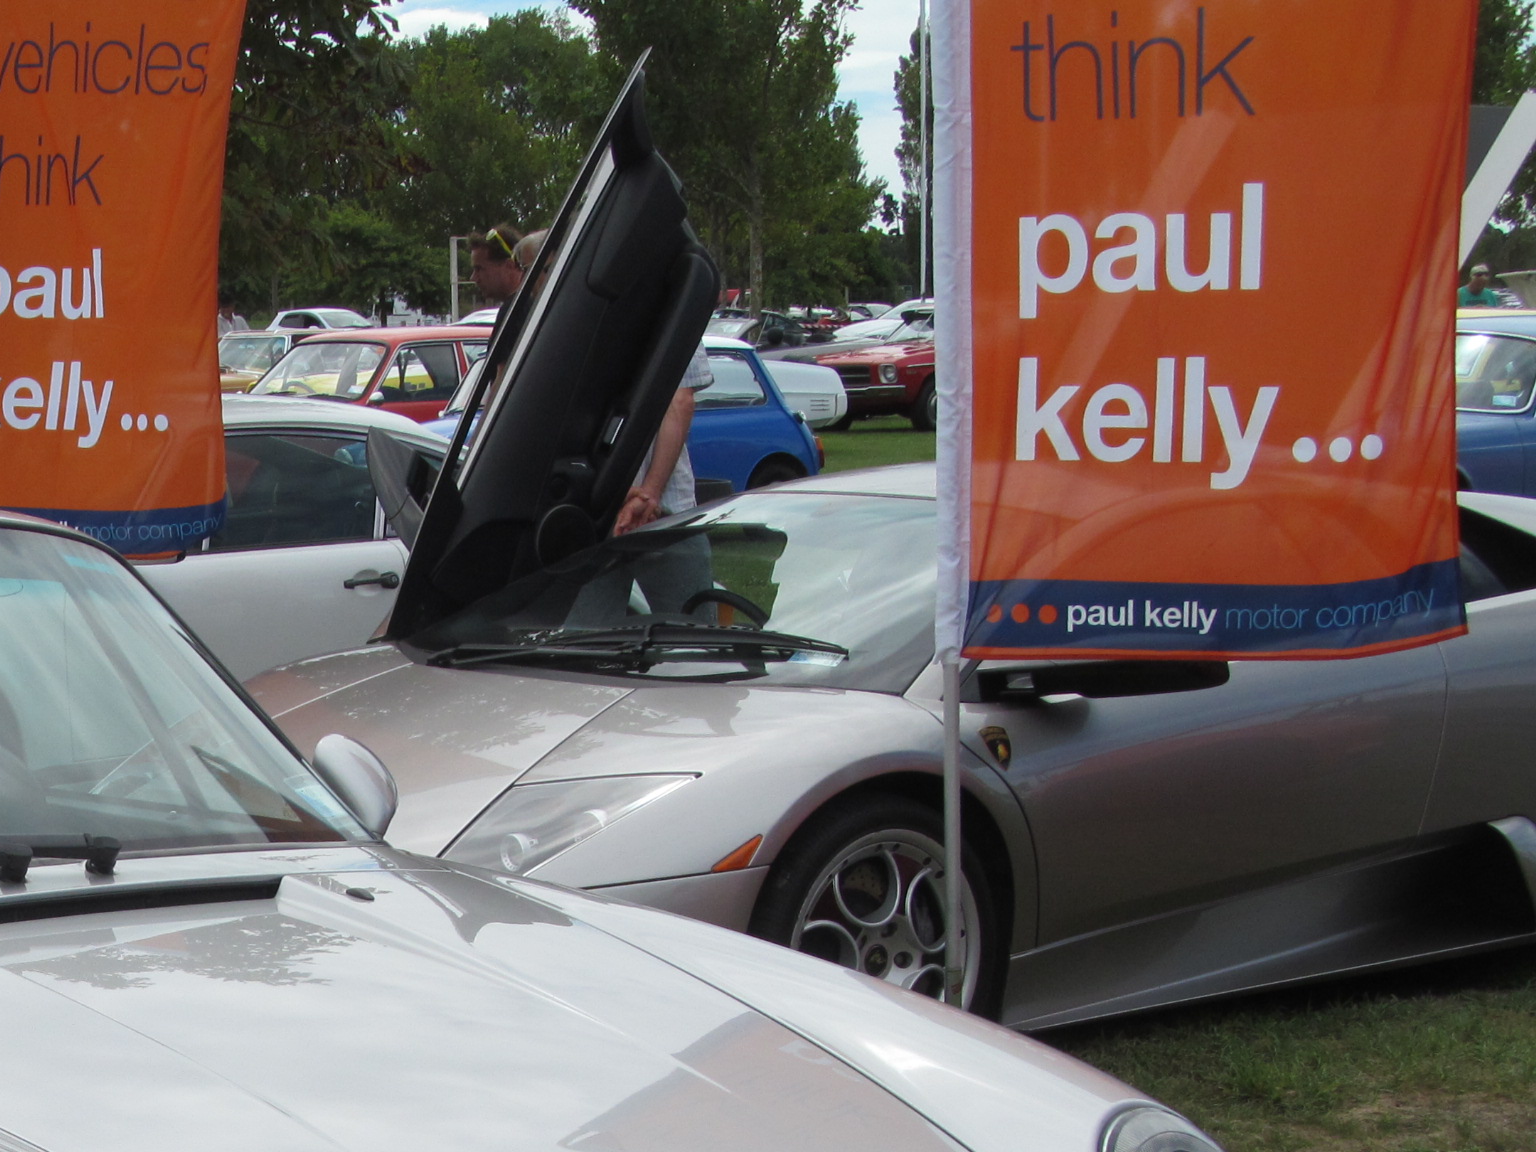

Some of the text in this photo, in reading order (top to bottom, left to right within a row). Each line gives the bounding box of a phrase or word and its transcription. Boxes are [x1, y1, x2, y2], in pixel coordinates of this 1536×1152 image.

[1009, 6, 1256, 123] think
[1017, 182, 1265, 320] paul
[1014, 356, 1384, 490] kelly...
[137, 512, 222, 541] company
[1067, 587, 1435, 635] paul kelly motor company
